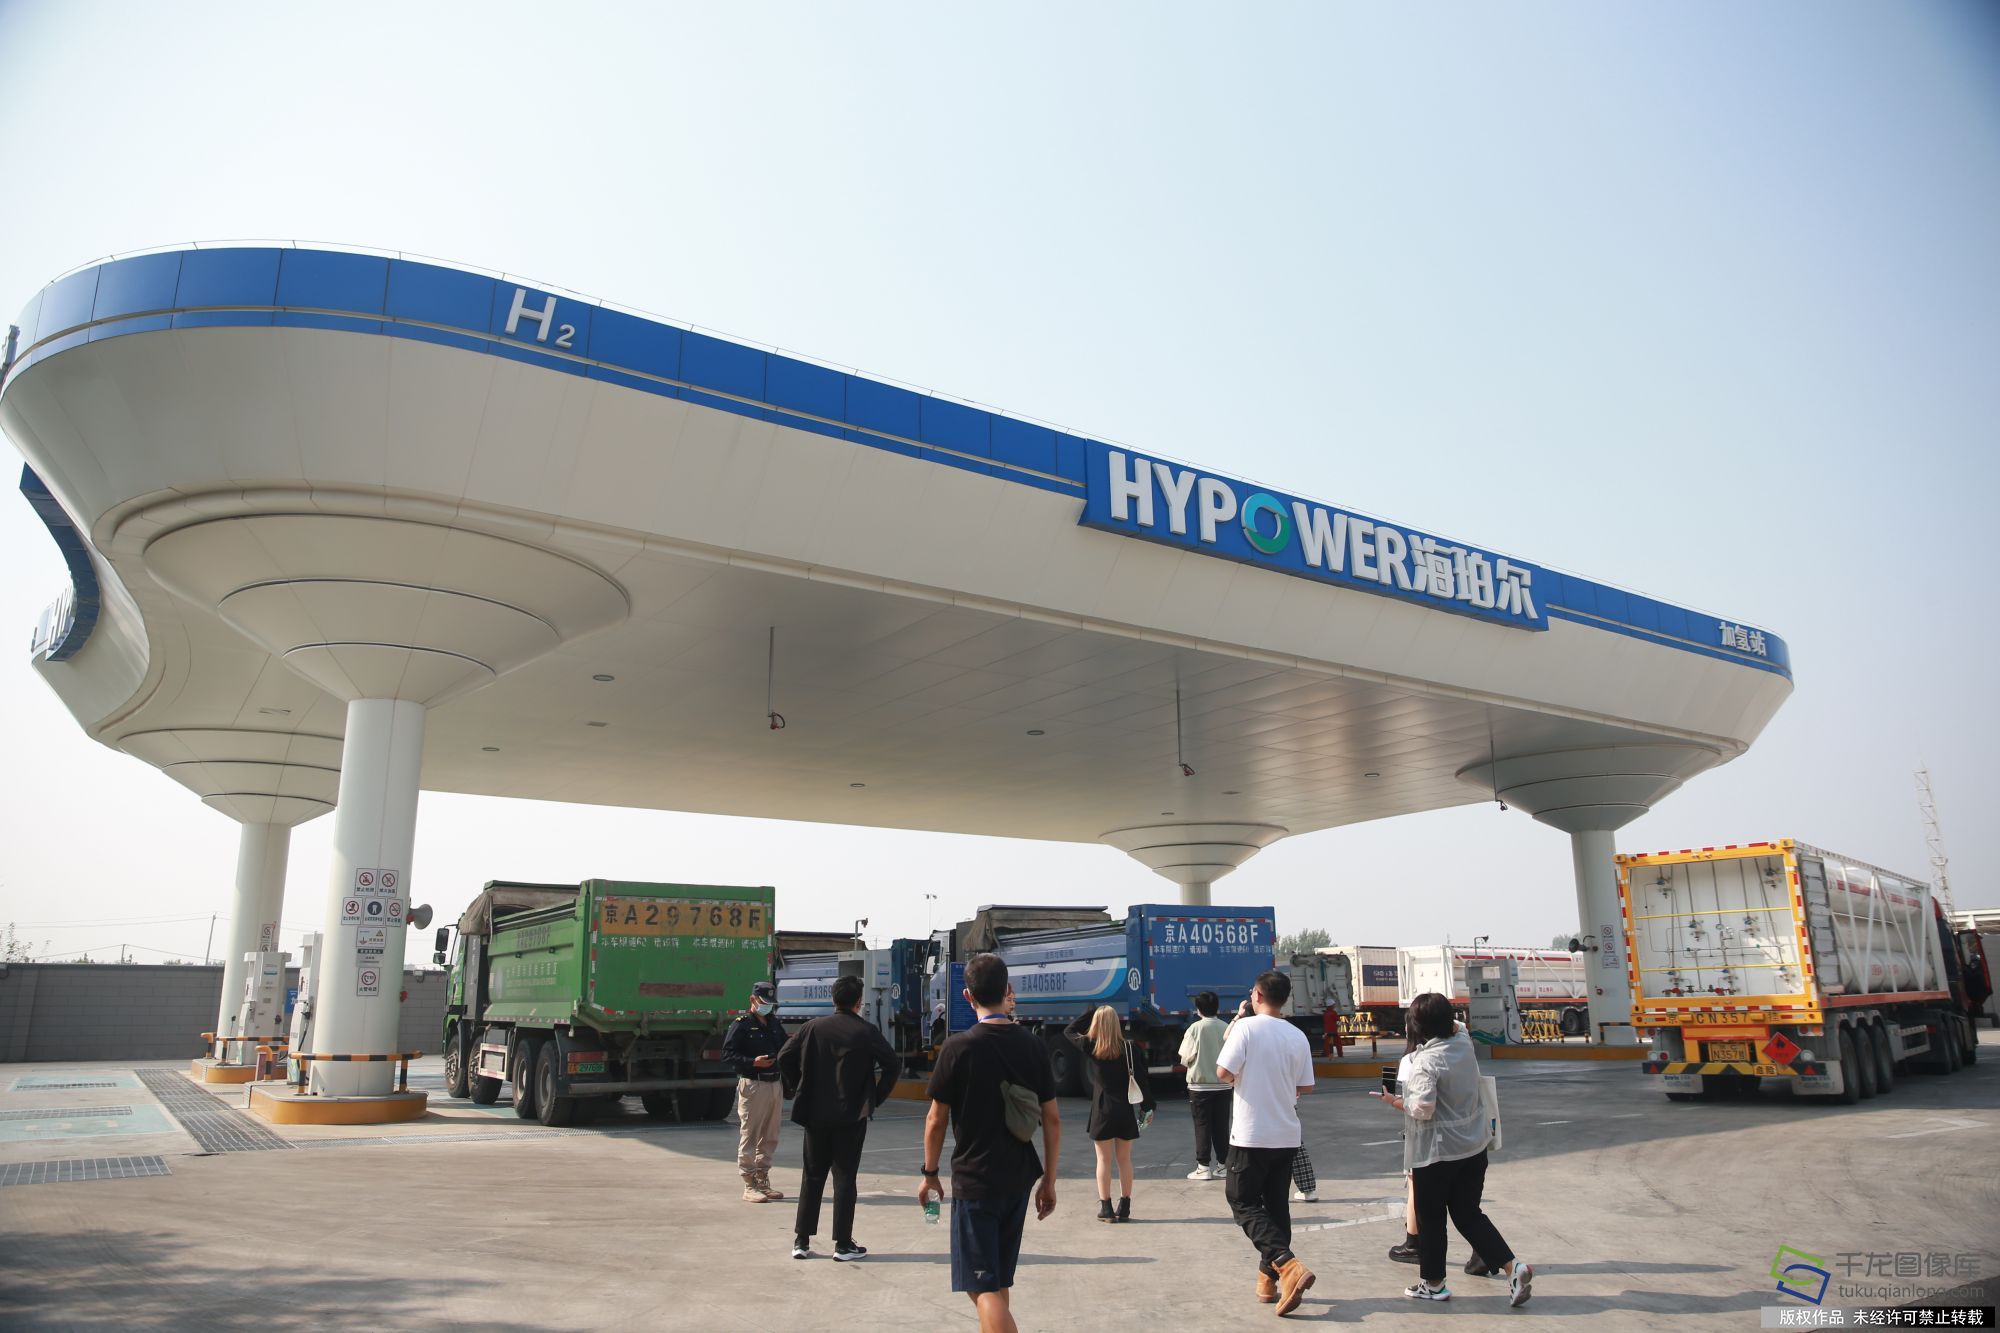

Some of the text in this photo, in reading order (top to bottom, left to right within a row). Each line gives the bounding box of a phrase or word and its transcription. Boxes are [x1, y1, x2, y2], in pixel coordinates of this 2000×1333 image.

[1411, 534, 1539, 619] 海珀尔
[1719, 621, 1767, 657] 加氢站
[605, 904, 761, 928] 京A29768F
[1164, 923, 1259, 944] 京A40568F
